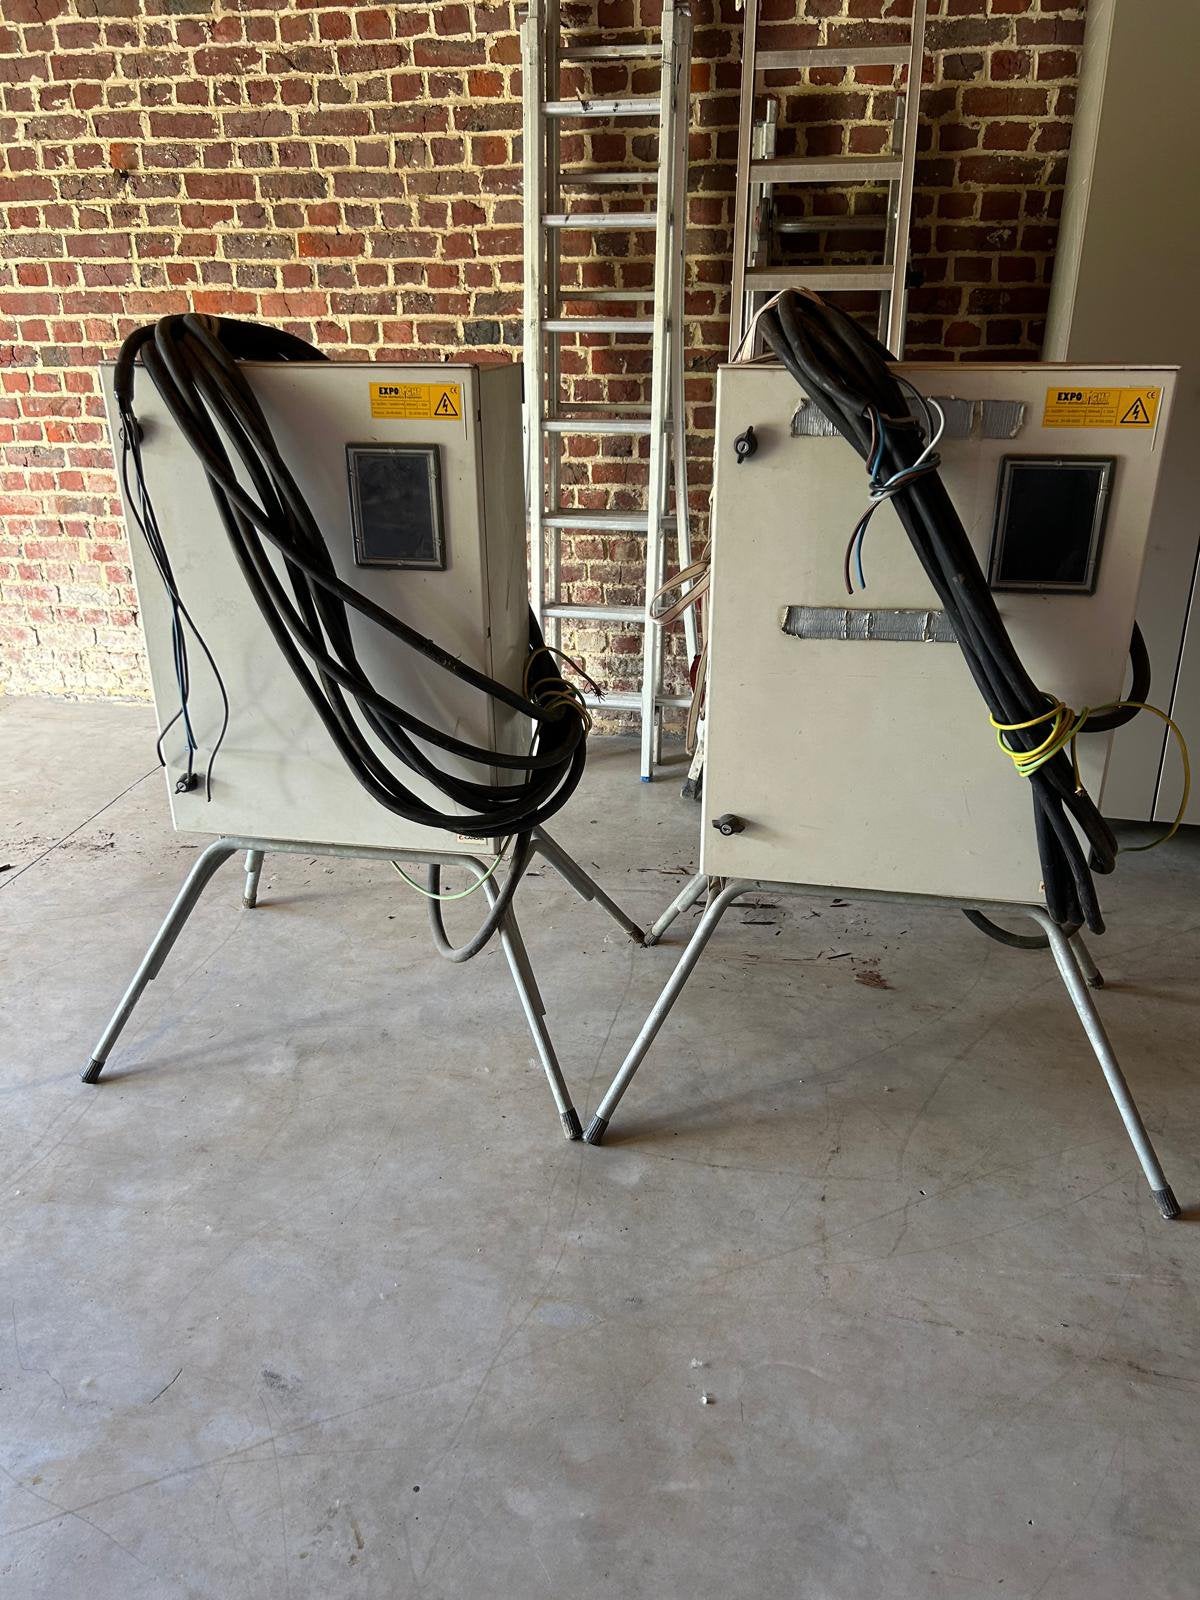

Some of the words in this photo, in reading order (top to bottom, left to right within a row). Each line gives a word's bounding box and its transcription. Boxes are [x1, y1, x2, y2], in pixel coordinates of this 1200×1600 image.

[378, 386, 399, 395] EXPO
[1146, 391, 1156, 399] CE
[1057, 391, 1083, 401] EXPO
